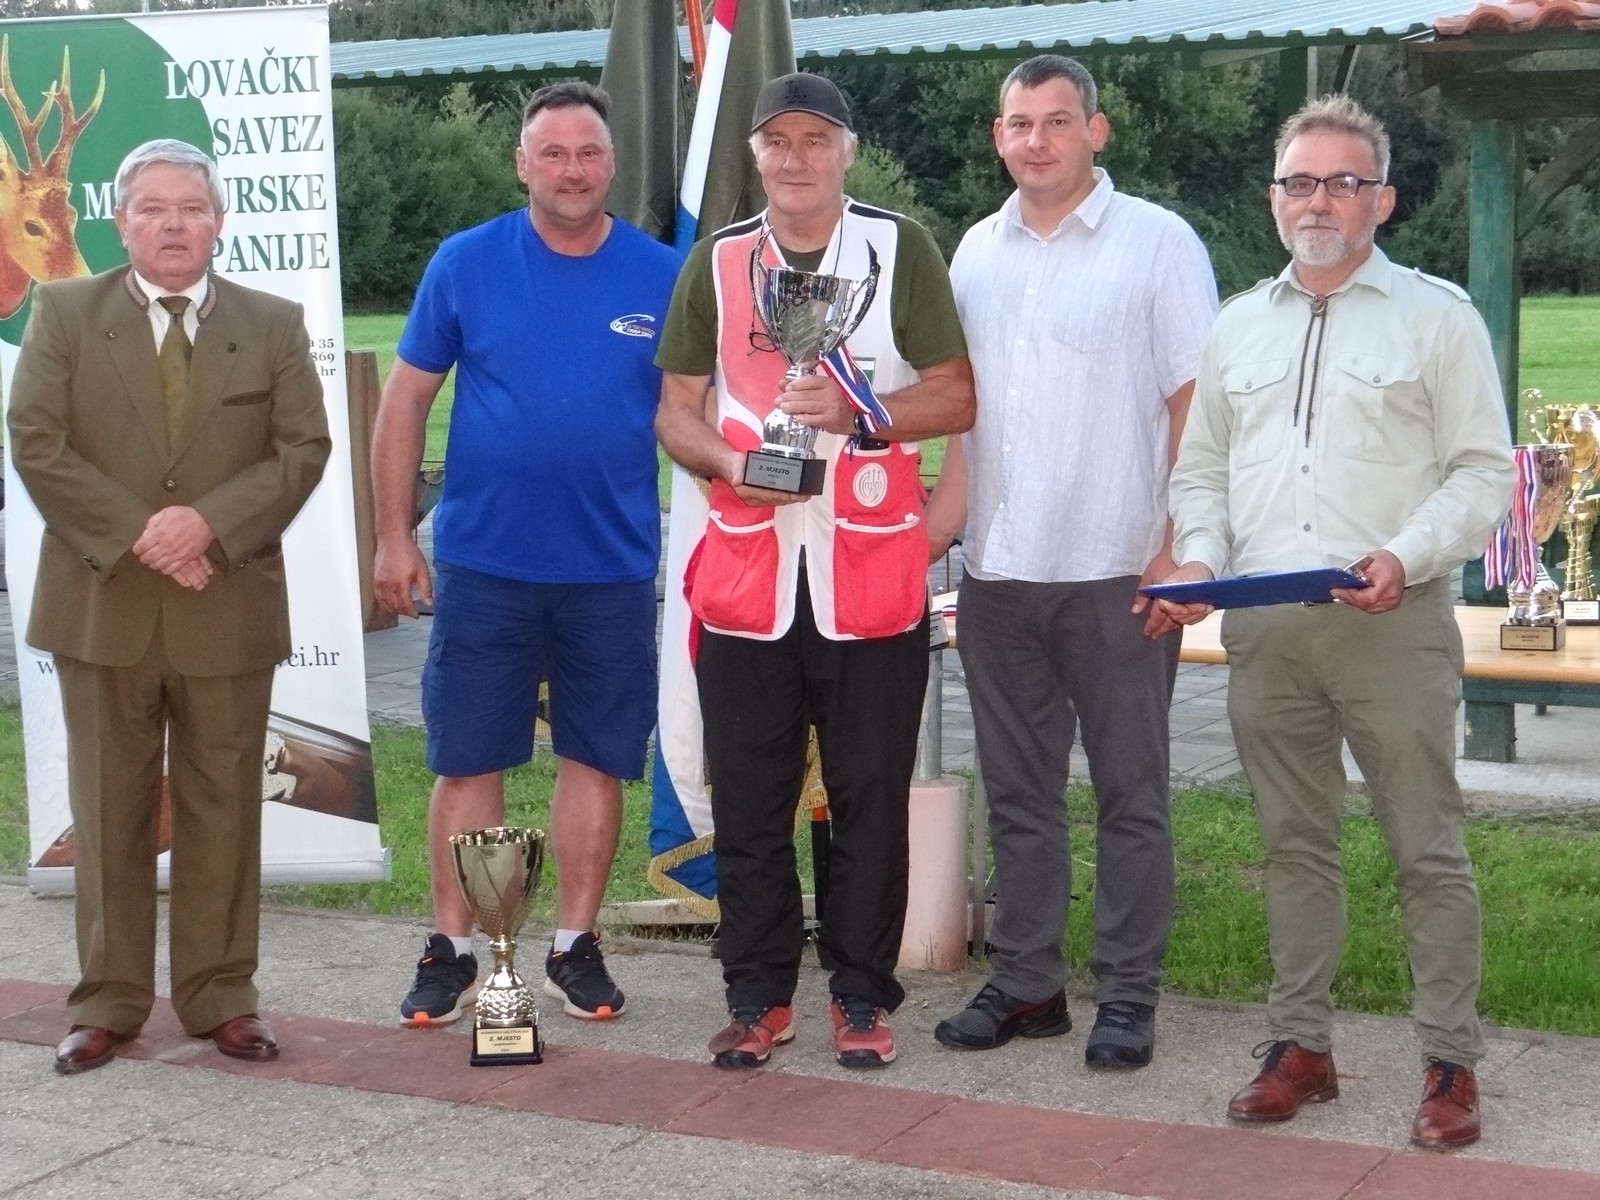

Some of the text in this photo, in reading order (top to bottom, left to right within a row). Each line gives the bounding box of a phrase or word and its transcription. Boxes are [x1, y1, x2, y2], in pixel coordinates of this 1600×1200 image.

[164, 47, 320, 99] LOVAČKI
[212, 115, 324, 156] SAVEZ
[319, 338, 335, 349] 35
[766, 466, 790, 475] MJESTO
